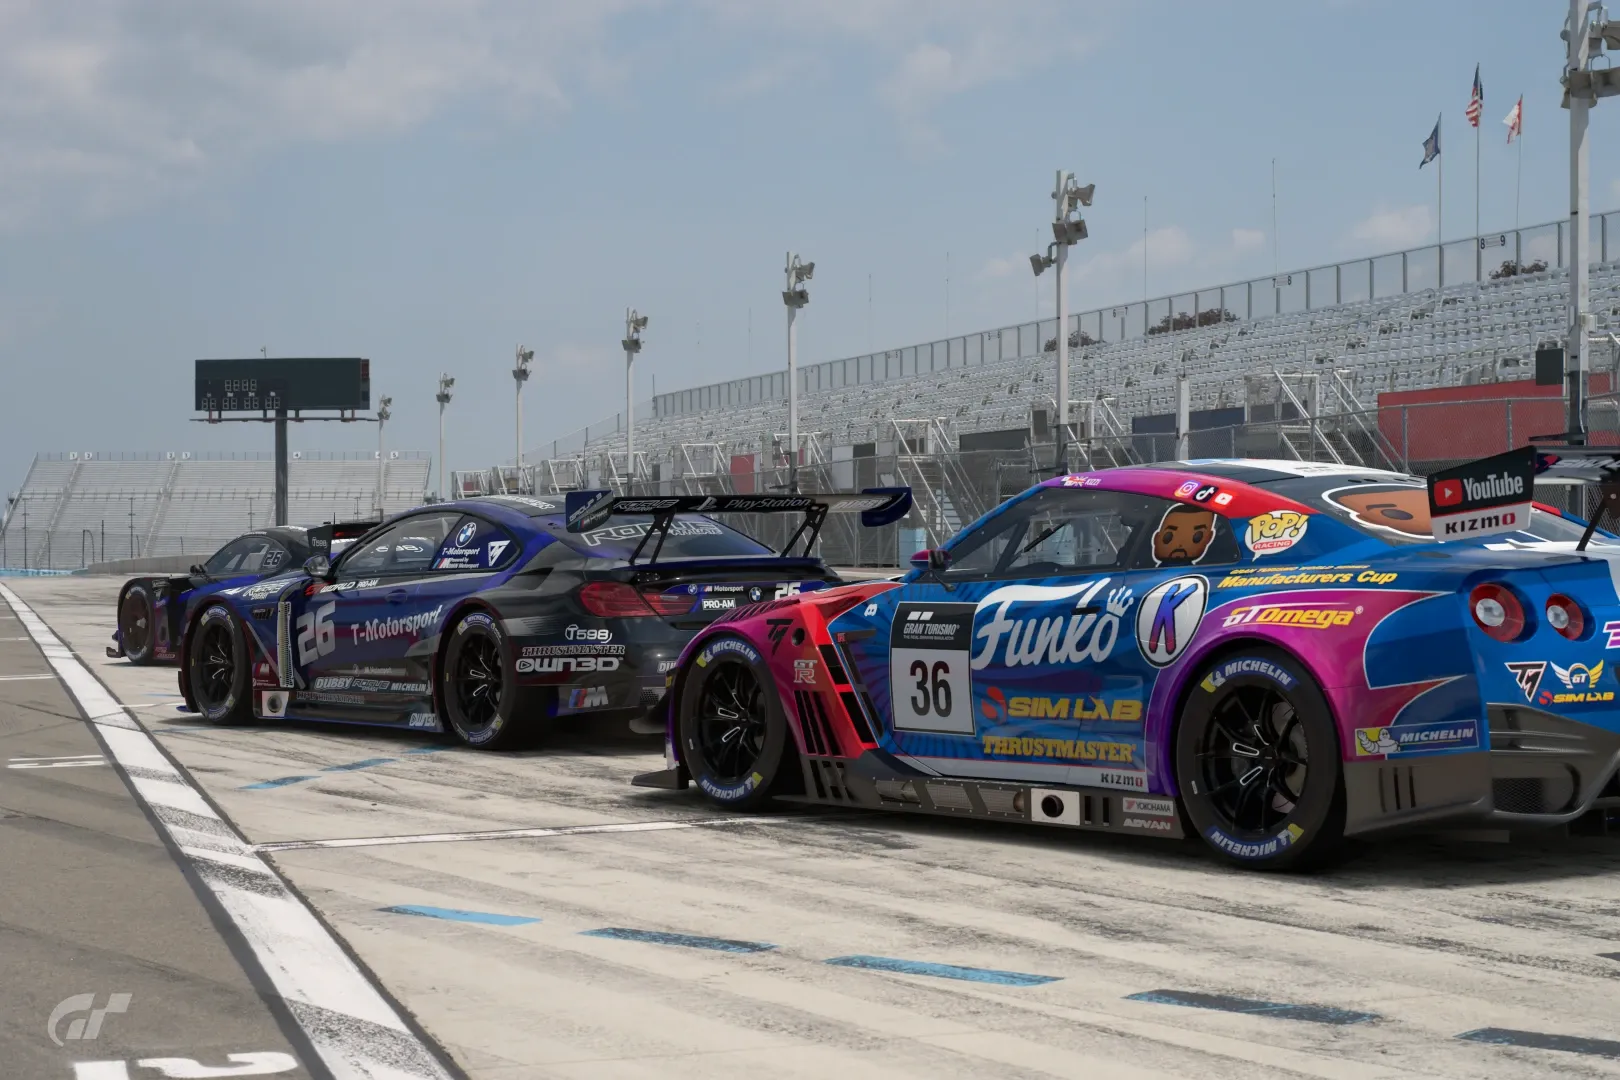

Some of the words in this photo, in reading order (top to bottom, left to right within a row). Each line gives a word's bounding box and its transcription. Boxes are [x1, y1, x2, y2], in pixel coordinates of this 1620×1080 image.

[1480, 238, 1485, 249] 8
[1500, 235, 1506, 246] 9
[1464, 472, 1523, 501] YouTube
[725, 498, 811, 510] PlayStation
[442, 547, 480, 555] T-Motorsport
[1254, 541, 1291, 550] RACING
[264, 551, 284, 566] 26
[1217, 572, 1353, 588] Manufacturers
[1357, 570, 1398, 585] Cup
[713, 585, 744, 593] Motorsport
[703, 600, 735, 609] PRO-AM
[351, 605, 443, 646] T-Motorsport
[971, 577, 1121, 670] Funko
[1148, 583, 1198, 655] K
[296, 600, 336, 667] 26
[904, 623, 925, 634] GRAN
[522, 644, 626, 656] THRUSTMASTER
[713, 641, 756, 661] MICHELIN
[1225, 659, 1292, 686] MICHELIN
[315, 677, 353, 690] DUBBY
[391, 682, 427, 691] MICHELIN
[910, 660, 952, 717] 36
[1553, 693, 1585, 703] SIM
[1586, 691, 1615, 702] LAB
[1008, 697, 1070, 719] SIM
[1073, 696, 1143, 721] LAB
[1400, 727, 1474, 743] MICHELIN
[983, 736, 1137, 763] THRUSTMASTER
[701, 779, 745, 799] MICHELIN
[1136, 802, 1171, 812] YOKOHAMA
[1123, 818, 1171, 830] ADVAN
[1211, 831, 1277, 857] MICHELIN
